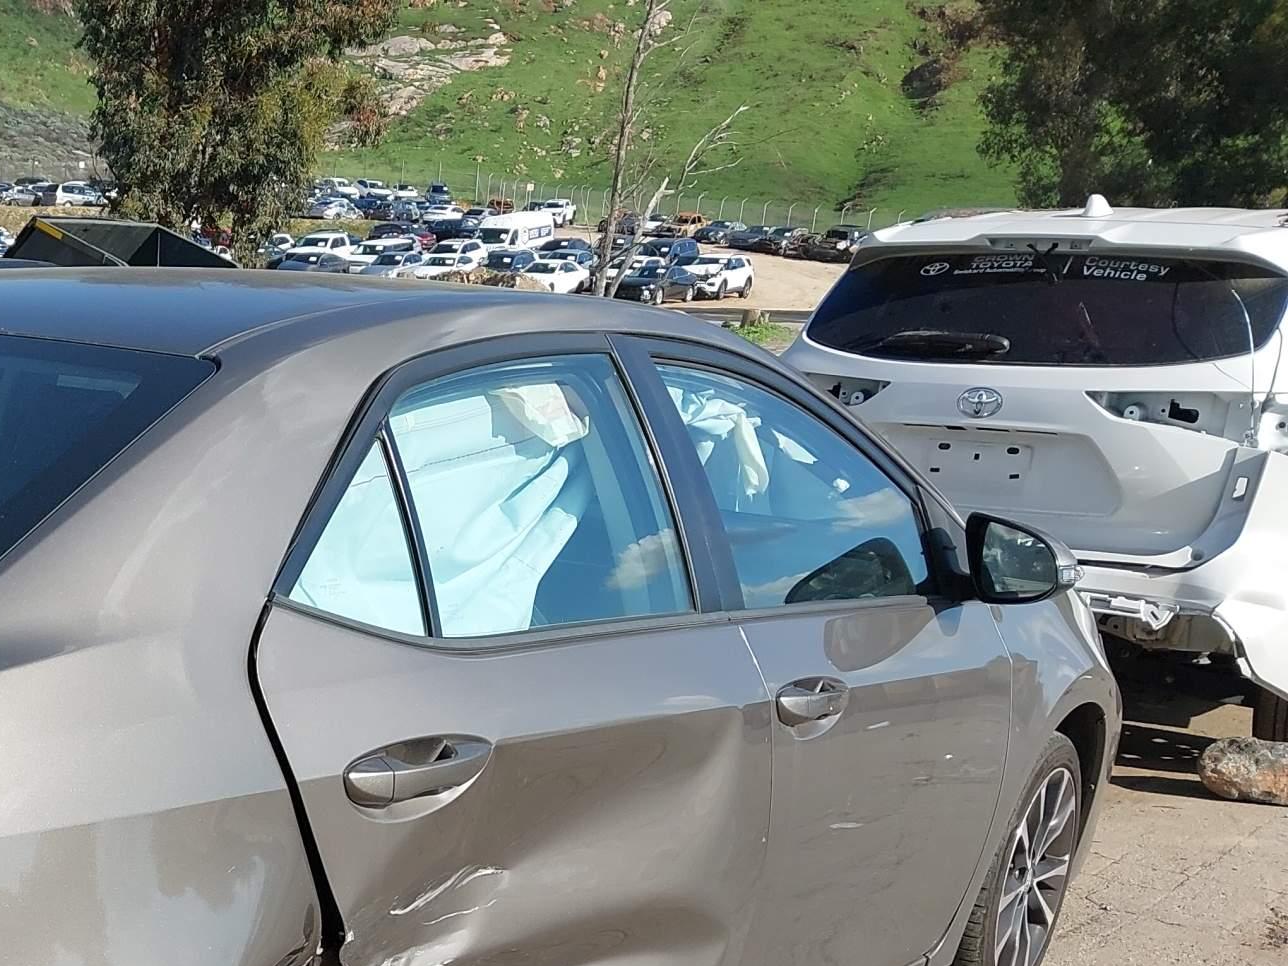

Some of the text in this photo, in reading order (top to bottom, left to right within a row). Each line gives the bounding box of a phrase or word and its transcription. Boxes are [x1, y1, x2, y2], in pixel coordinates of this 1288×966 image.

[970, 260, 1033, 268] TOYOTA
[974, 254, 1035, 263] CROWN
[1085, 256, 1170, 276] Courtesy
[1083, 265, 1147, 281] Vehicle
